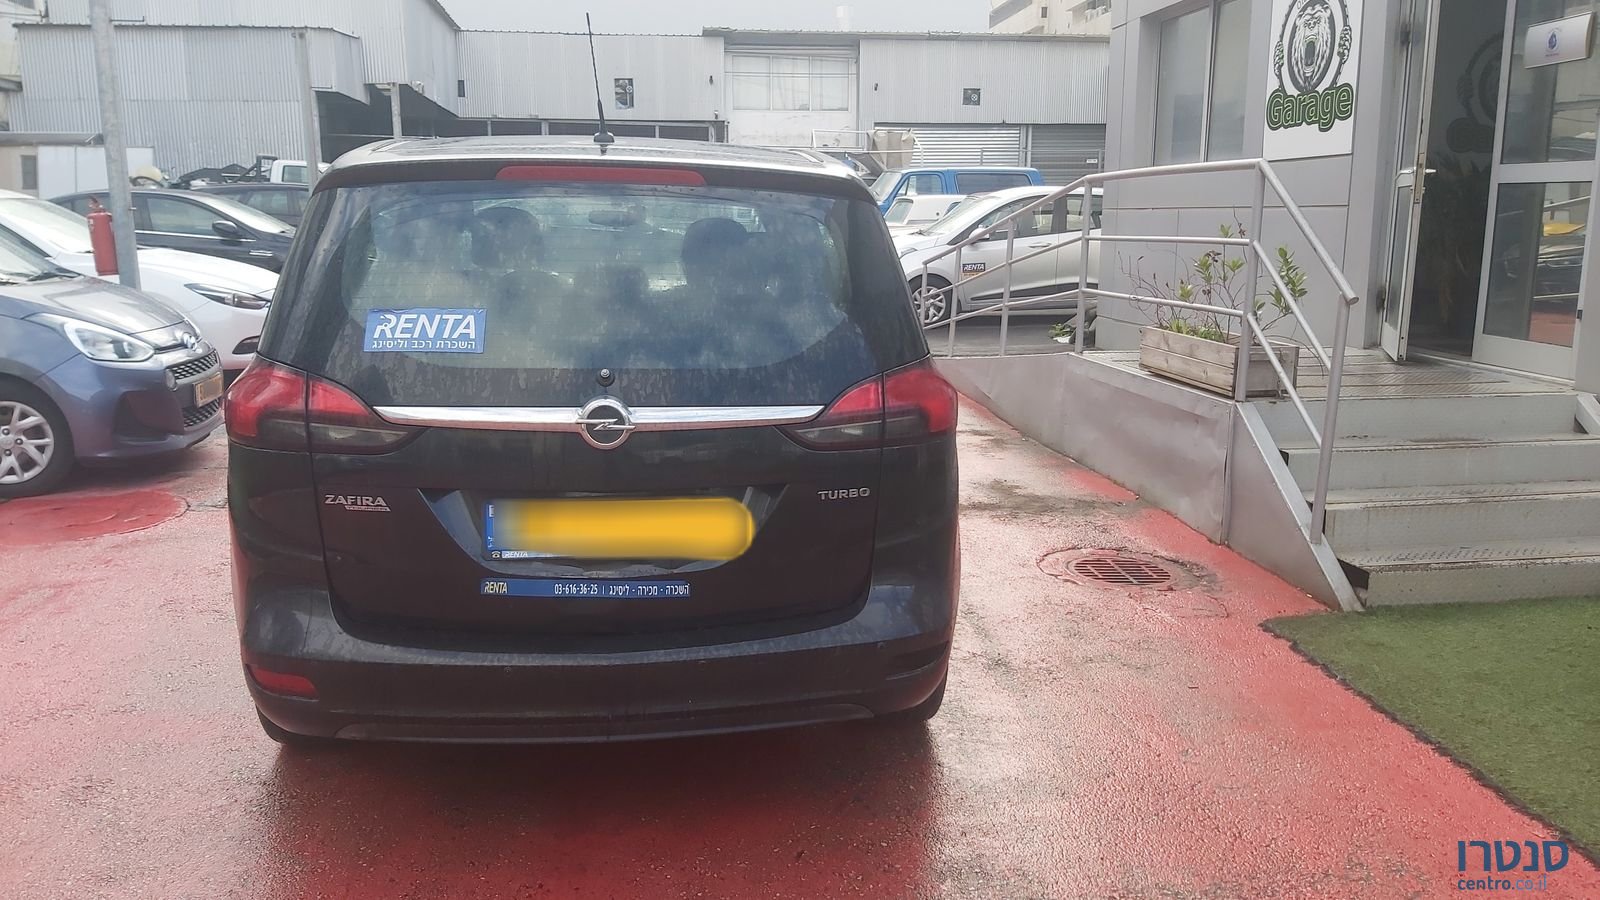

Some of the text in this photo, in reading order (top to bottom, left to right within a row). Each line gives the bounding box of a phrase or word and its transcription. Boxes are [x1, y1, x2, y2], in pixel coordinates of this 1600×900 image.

[1267, 84, 1353, 131] Garage
[373, 314, 476, 339] RENTA
[372, 339, 475, 349] השכרת רכב וליסינג
[817, 487, 870, 500] TURBO
[324, 494, 387, 506] ZAFIRA
[484, 582, 508, 594] RENTA
[554, 583, 690, 595] השכרה מכירה ליסינג 03-616-36-25
